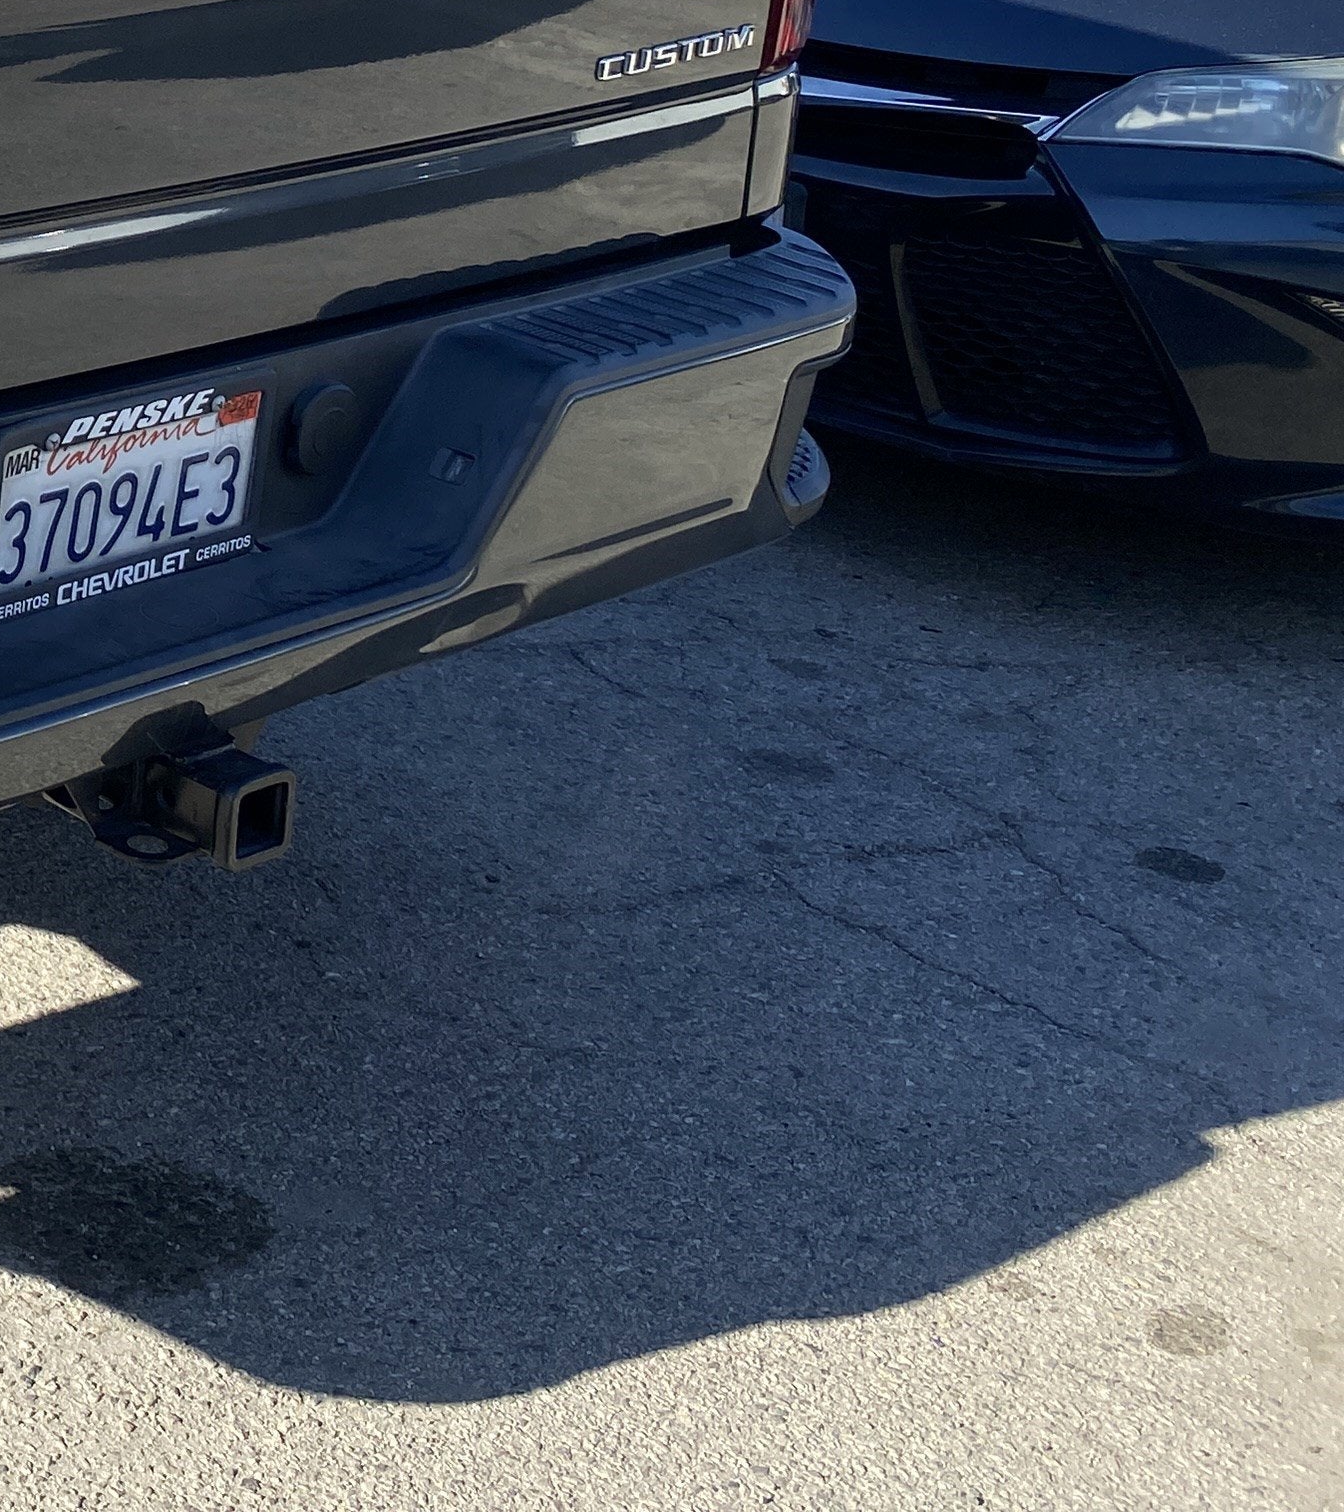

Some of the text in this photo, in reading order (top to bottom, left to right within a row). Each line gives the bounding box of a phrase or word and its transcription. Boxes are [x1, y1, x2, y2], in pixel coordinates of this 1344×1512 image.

[595, 23, 756, 81] CUSTOM
[62, 388, 215, 445] PENSKE
[5, 448, 41, 479] MAR
[46, 416, 213, 476] California
[56, 548, 190, 606] CHEVROLET
[195, 534, 252, 563] CERRITOS
